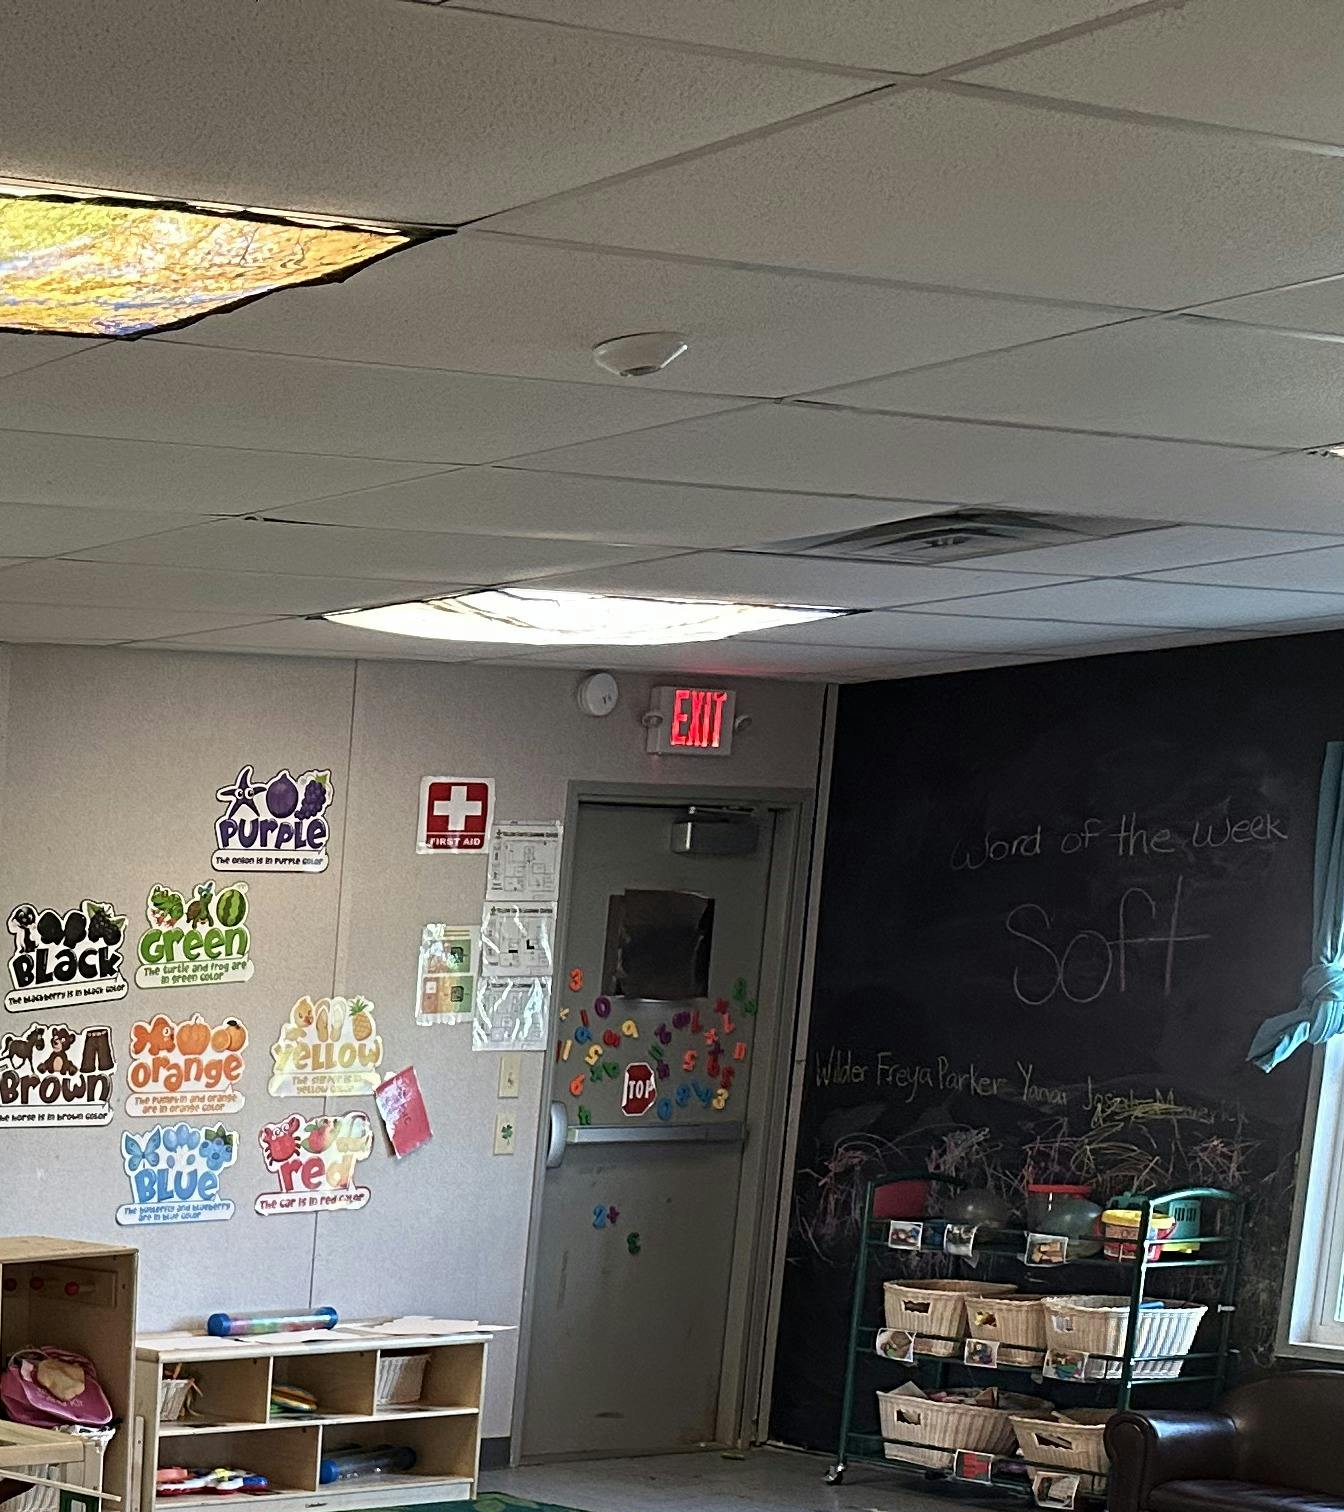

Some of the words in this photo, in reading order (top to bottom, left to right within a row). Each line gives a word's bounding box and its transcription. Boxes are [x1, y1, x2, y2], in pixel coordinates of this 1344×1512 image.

[671, 689, 727, 747] EXIT
[429, 837, 461, 847] FIRST
[463, 837, 481, 846] AID
[1062, 818, 1102, 853] of
[1109, 812, 1177, 855] the
[141, 926, 248, 963] Green
[144, 966, 160, 977] The
[163, 963, 189, 974] turtle
[192, 963, 209, 972] and
[210, 962, 229, 973] frog
[232, 961, 247, 970] are
[172, 973, 198, 984] green
[627, 1079, 656, 1099] TOP
[877, 1052, 934, 1103] Freya
[938, 1056, 1008, 1096] Parker
[280, 1154, 354, 1192] red
[260, 1200, 277, 1209] The
[298, 1198, 306, 1207] is
[320, 1196, 337, 1206] red
